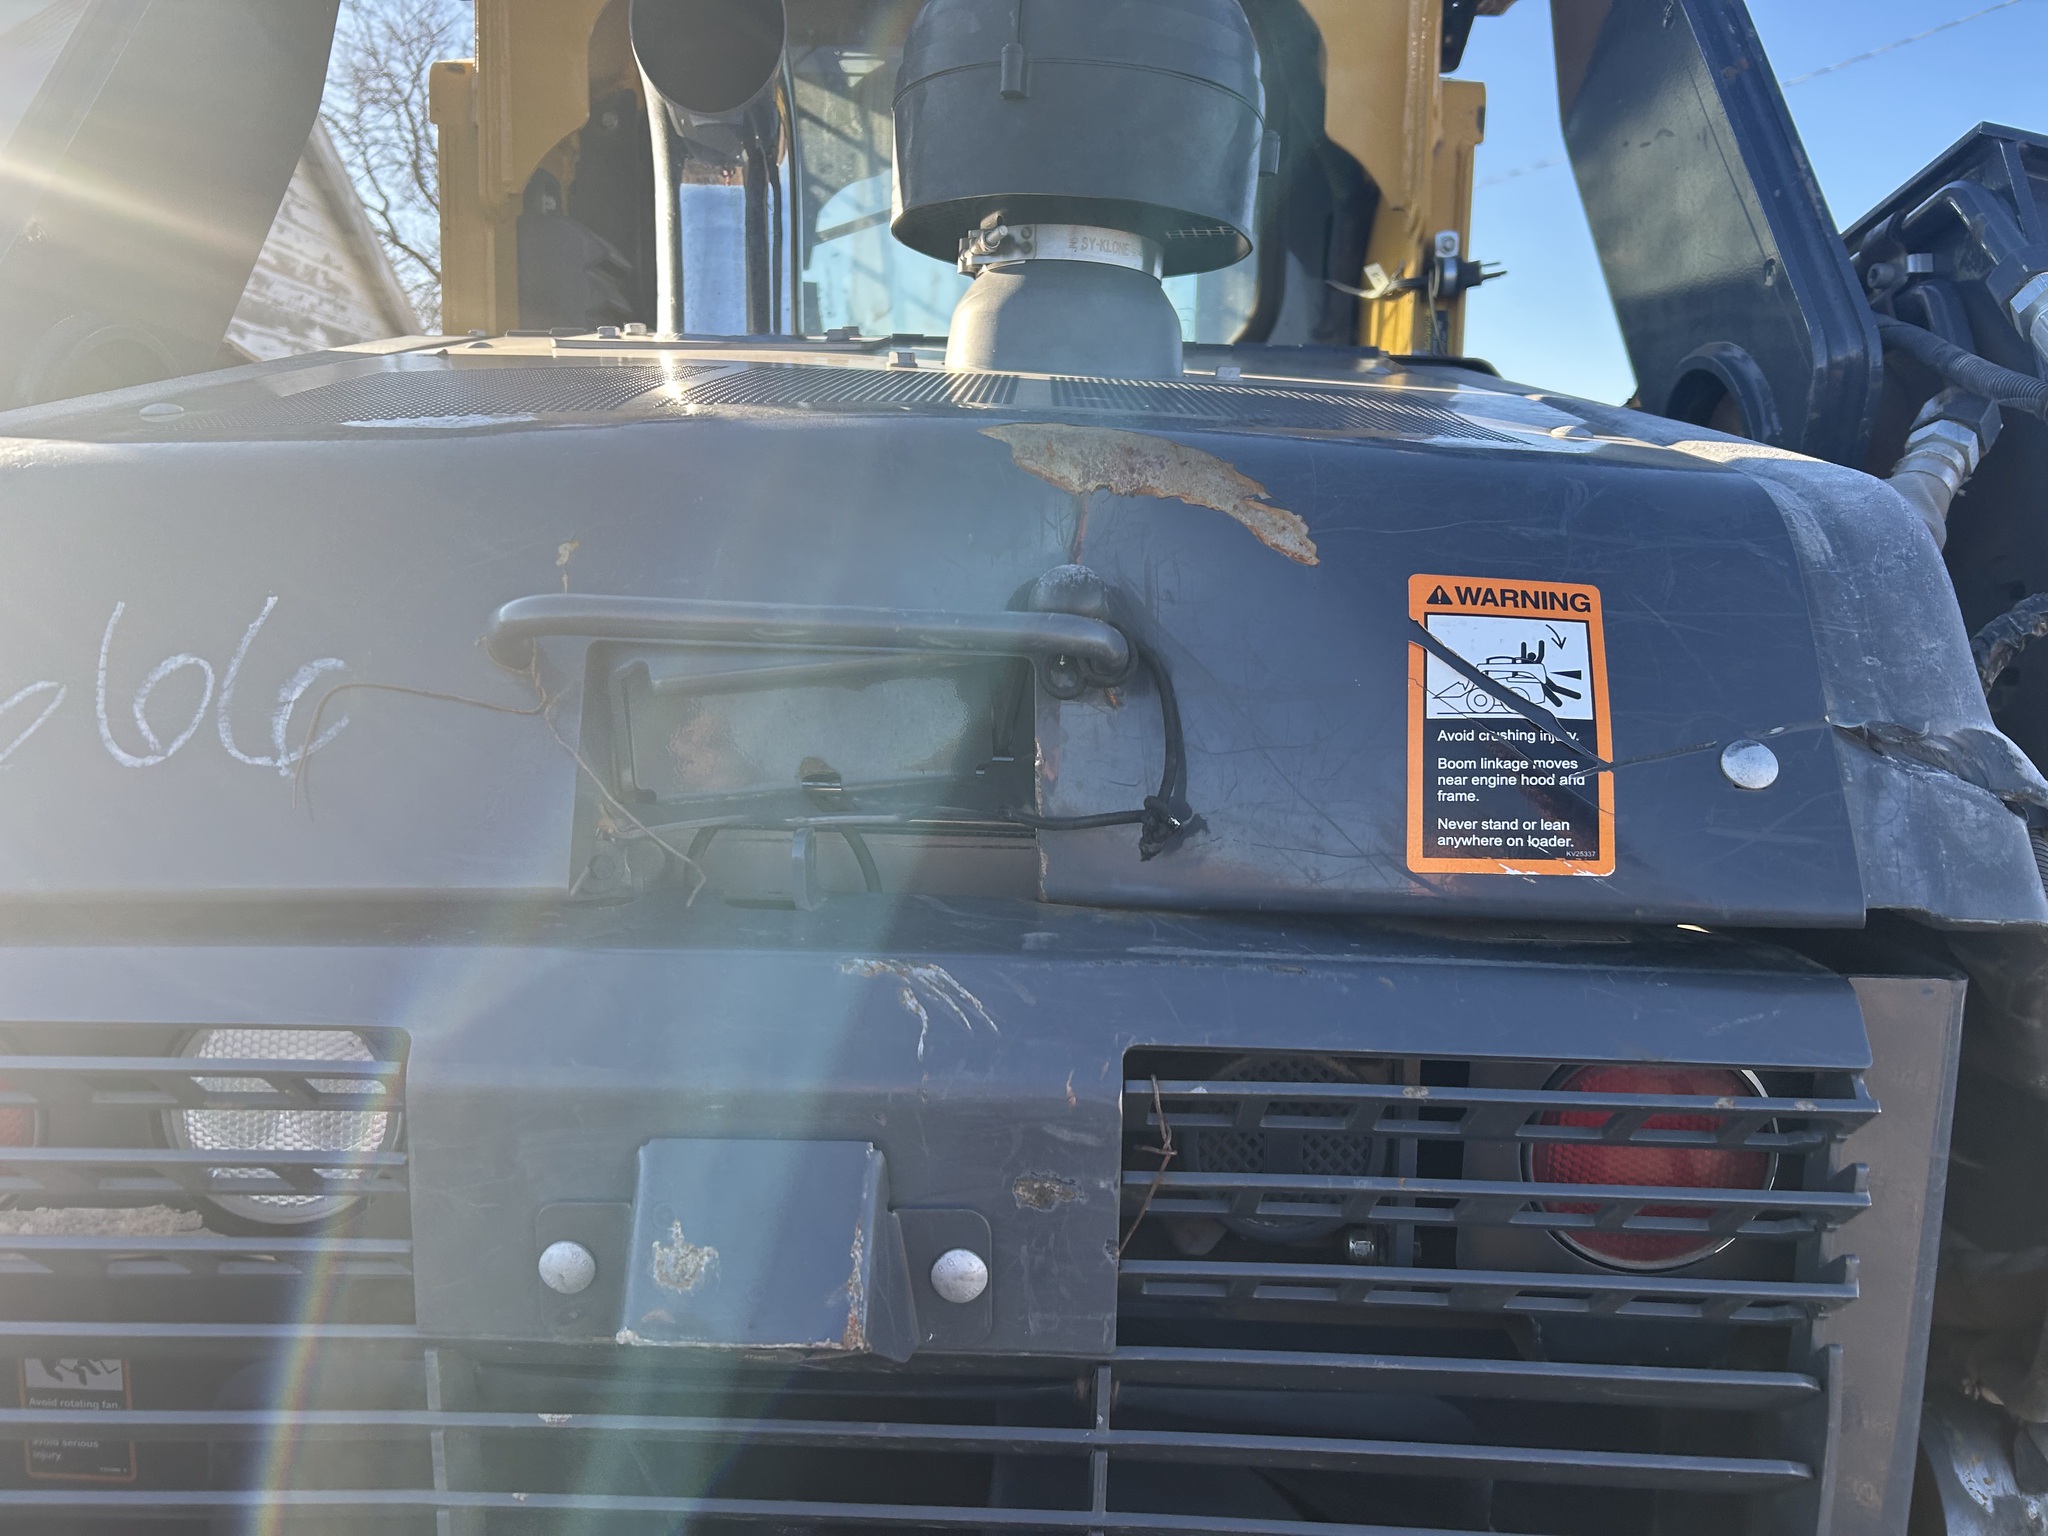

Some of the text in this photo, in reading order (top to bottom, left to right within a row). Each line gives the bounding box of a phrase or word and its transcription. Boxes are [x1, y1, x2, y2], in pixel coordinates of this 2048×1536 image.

[1080, 236, 1130, 256] SY-KLONE
[1454, 585, 1591, 613] WARNING
[1437, 729, 1475, 742] Avoid
[1438, 757, 1578, 773] Boom linkage moves
[1437, 774, 1586, 790] near engine hood and
[1437, 789, 1480, 802] frame.
[1438, 818, 1570, 831] Never stand or lean
[1437, 834, 1574, 850] anywhere on loader.
[28, 1397, 121, 1411] Avoid rotating fan.
